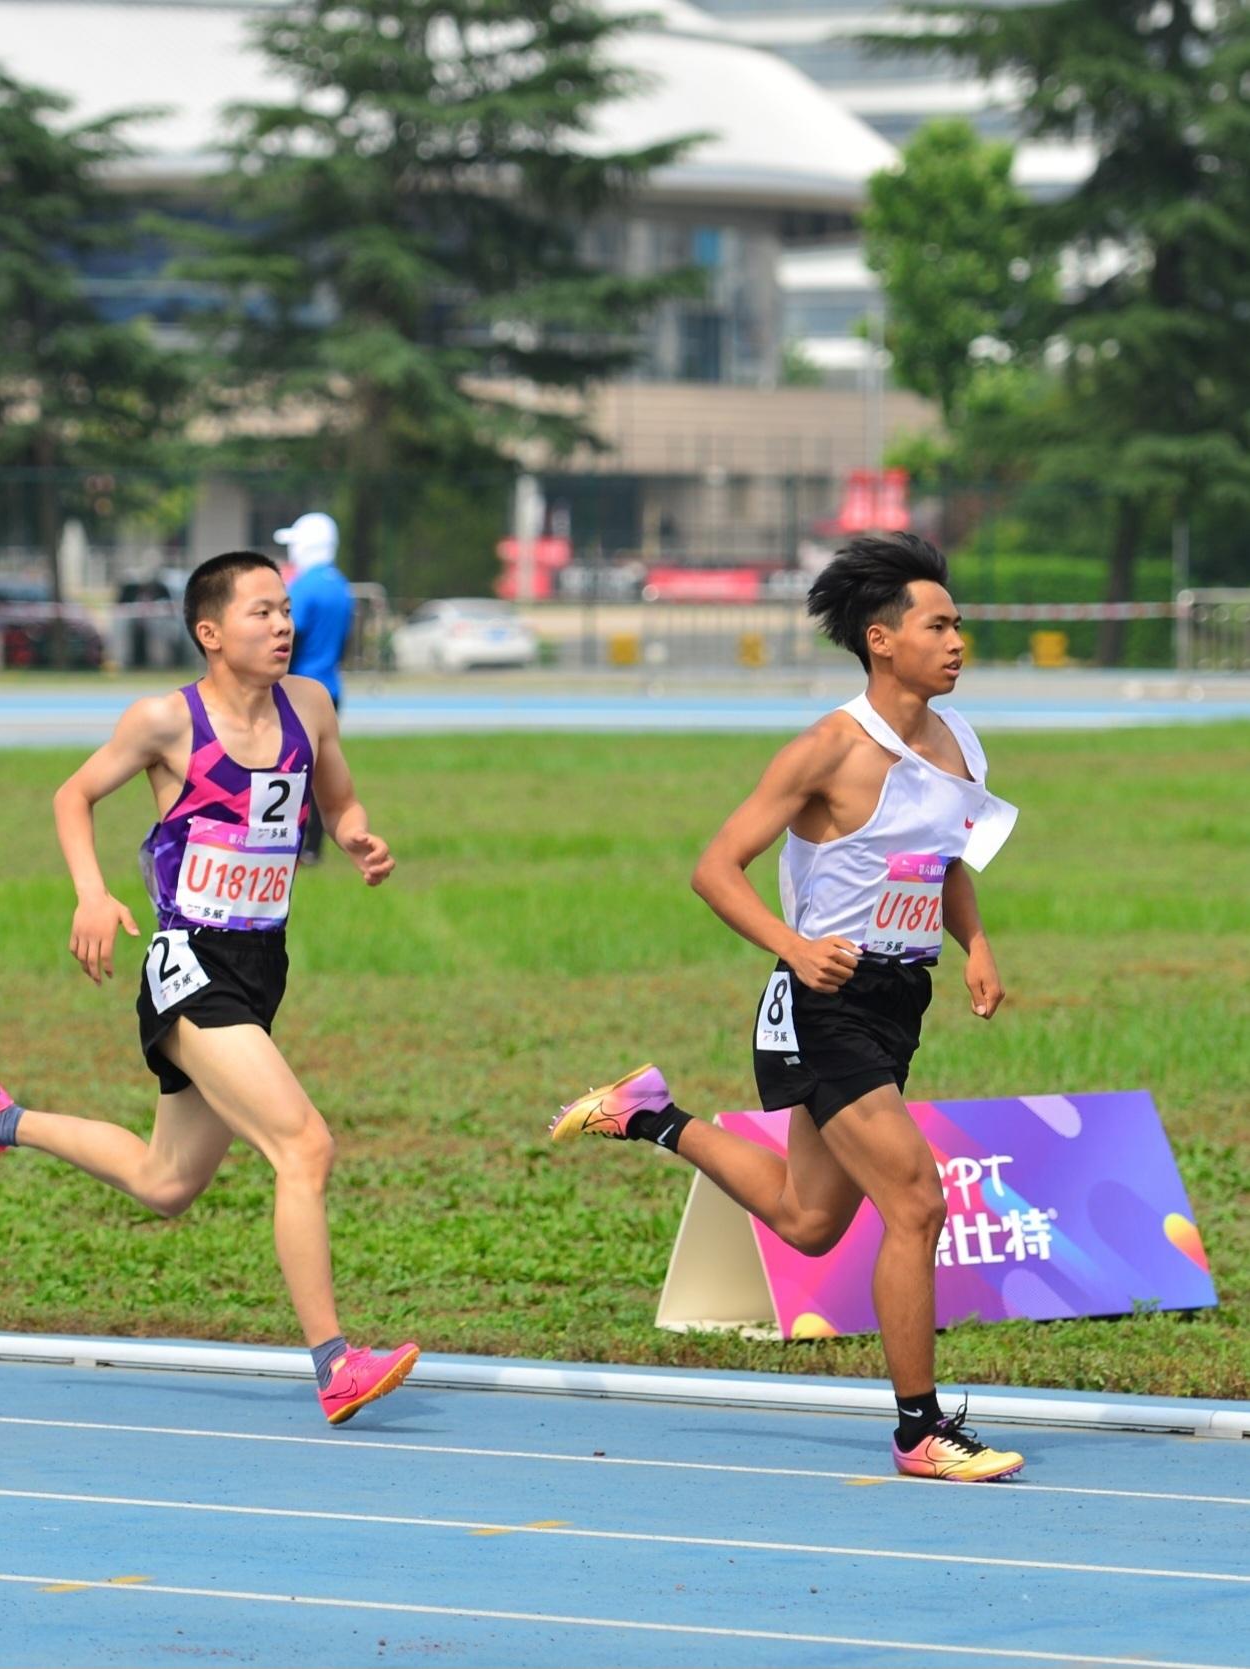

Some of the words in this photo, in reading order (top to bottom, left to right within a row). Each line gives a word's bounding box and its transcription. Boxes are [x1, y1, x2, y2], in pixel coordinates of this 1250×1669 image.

[261, 779, 291, 824] 2
[186, 854, 289, 904] U18126
[151, 936, 182, 984] 2
[767, 978, 788, 1026] 8
